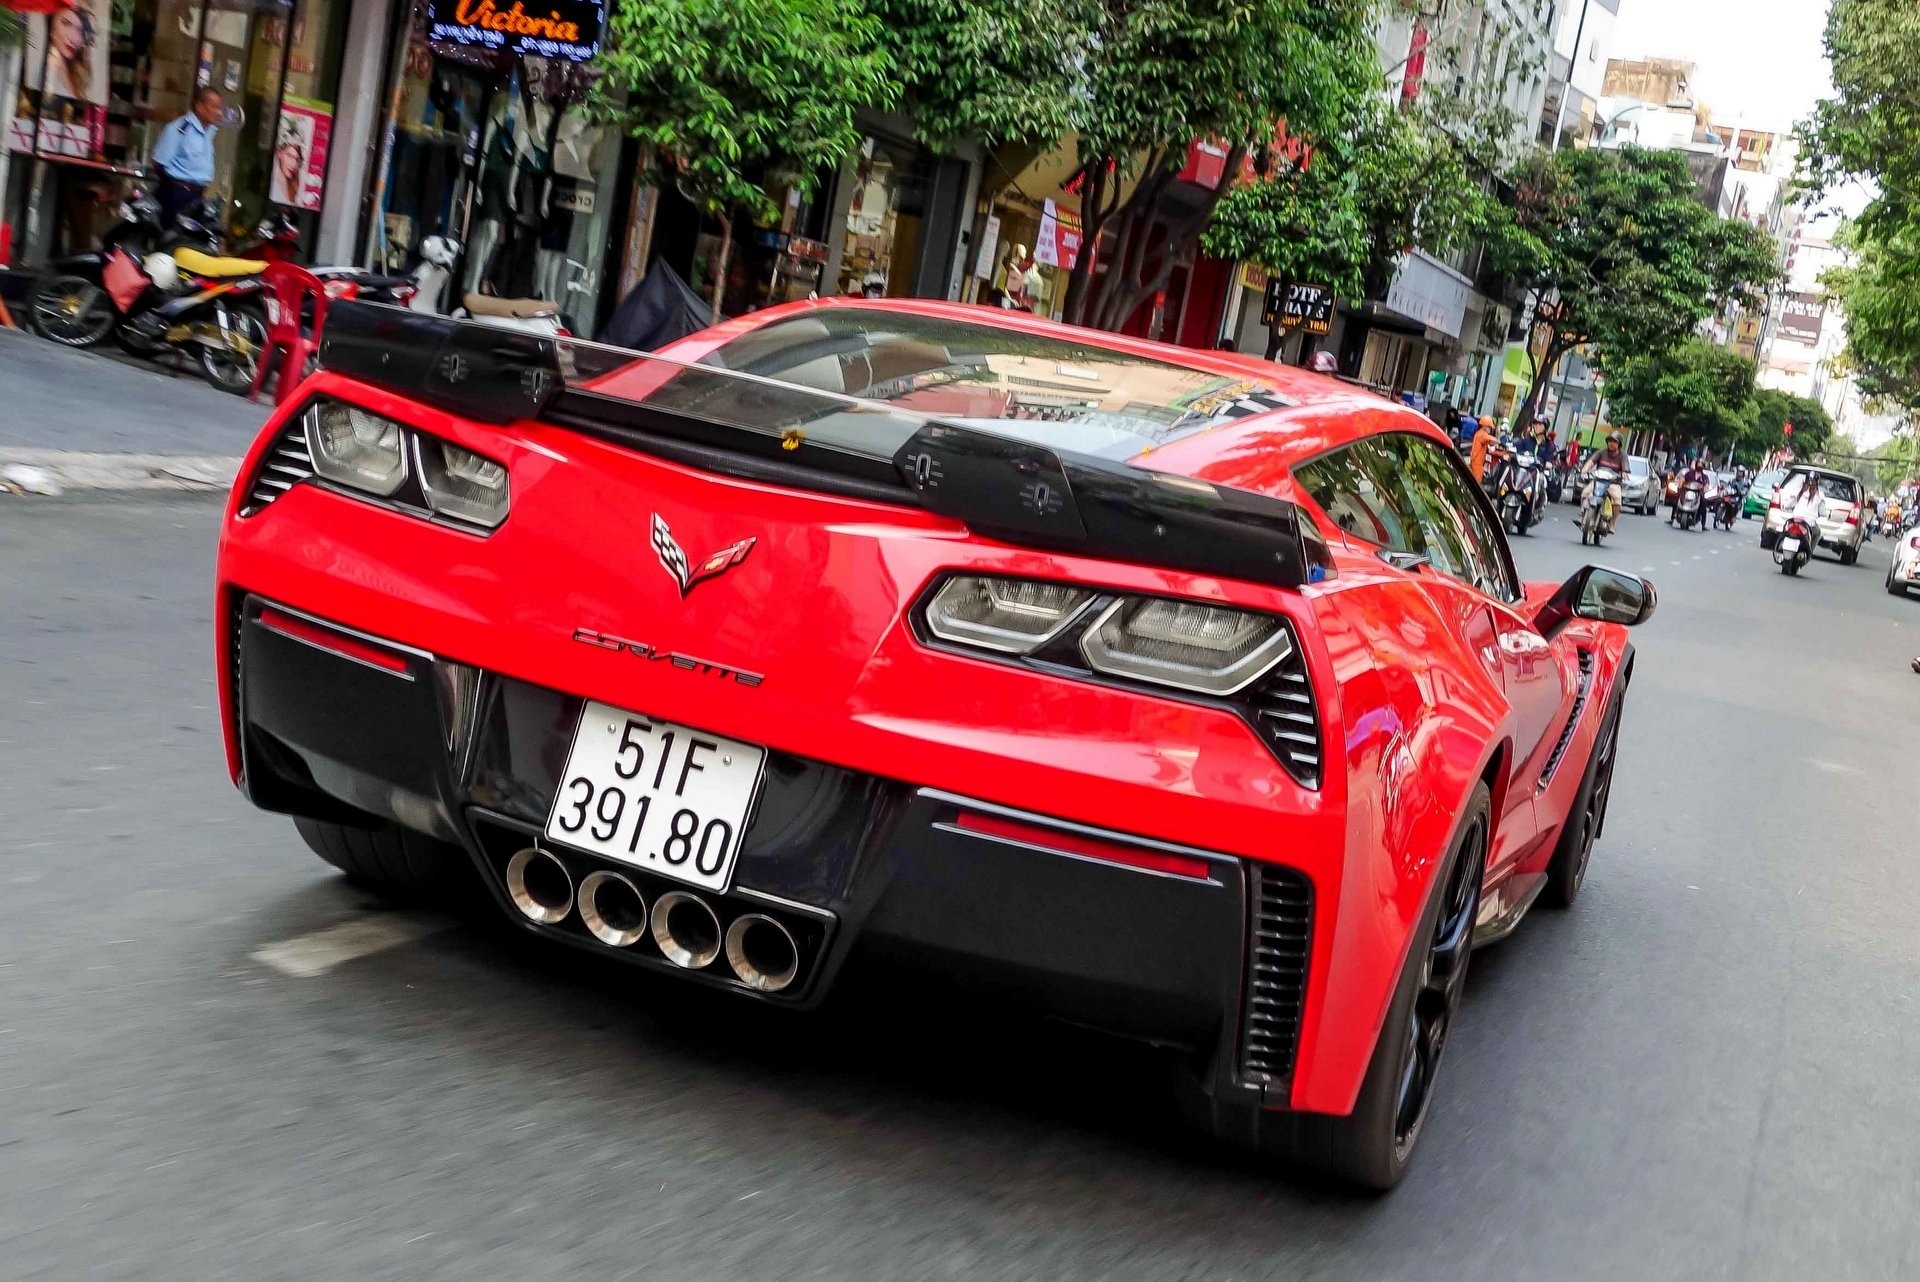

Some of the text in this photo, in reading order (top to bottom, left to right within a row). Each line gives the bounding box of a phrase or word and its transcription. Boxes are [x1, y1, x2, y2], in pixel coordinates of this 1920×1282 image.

[455, 0, 580, 42] Victoria
[614, 719, 718, 797] 51F
[559, 776, 733, 876] 391.80
